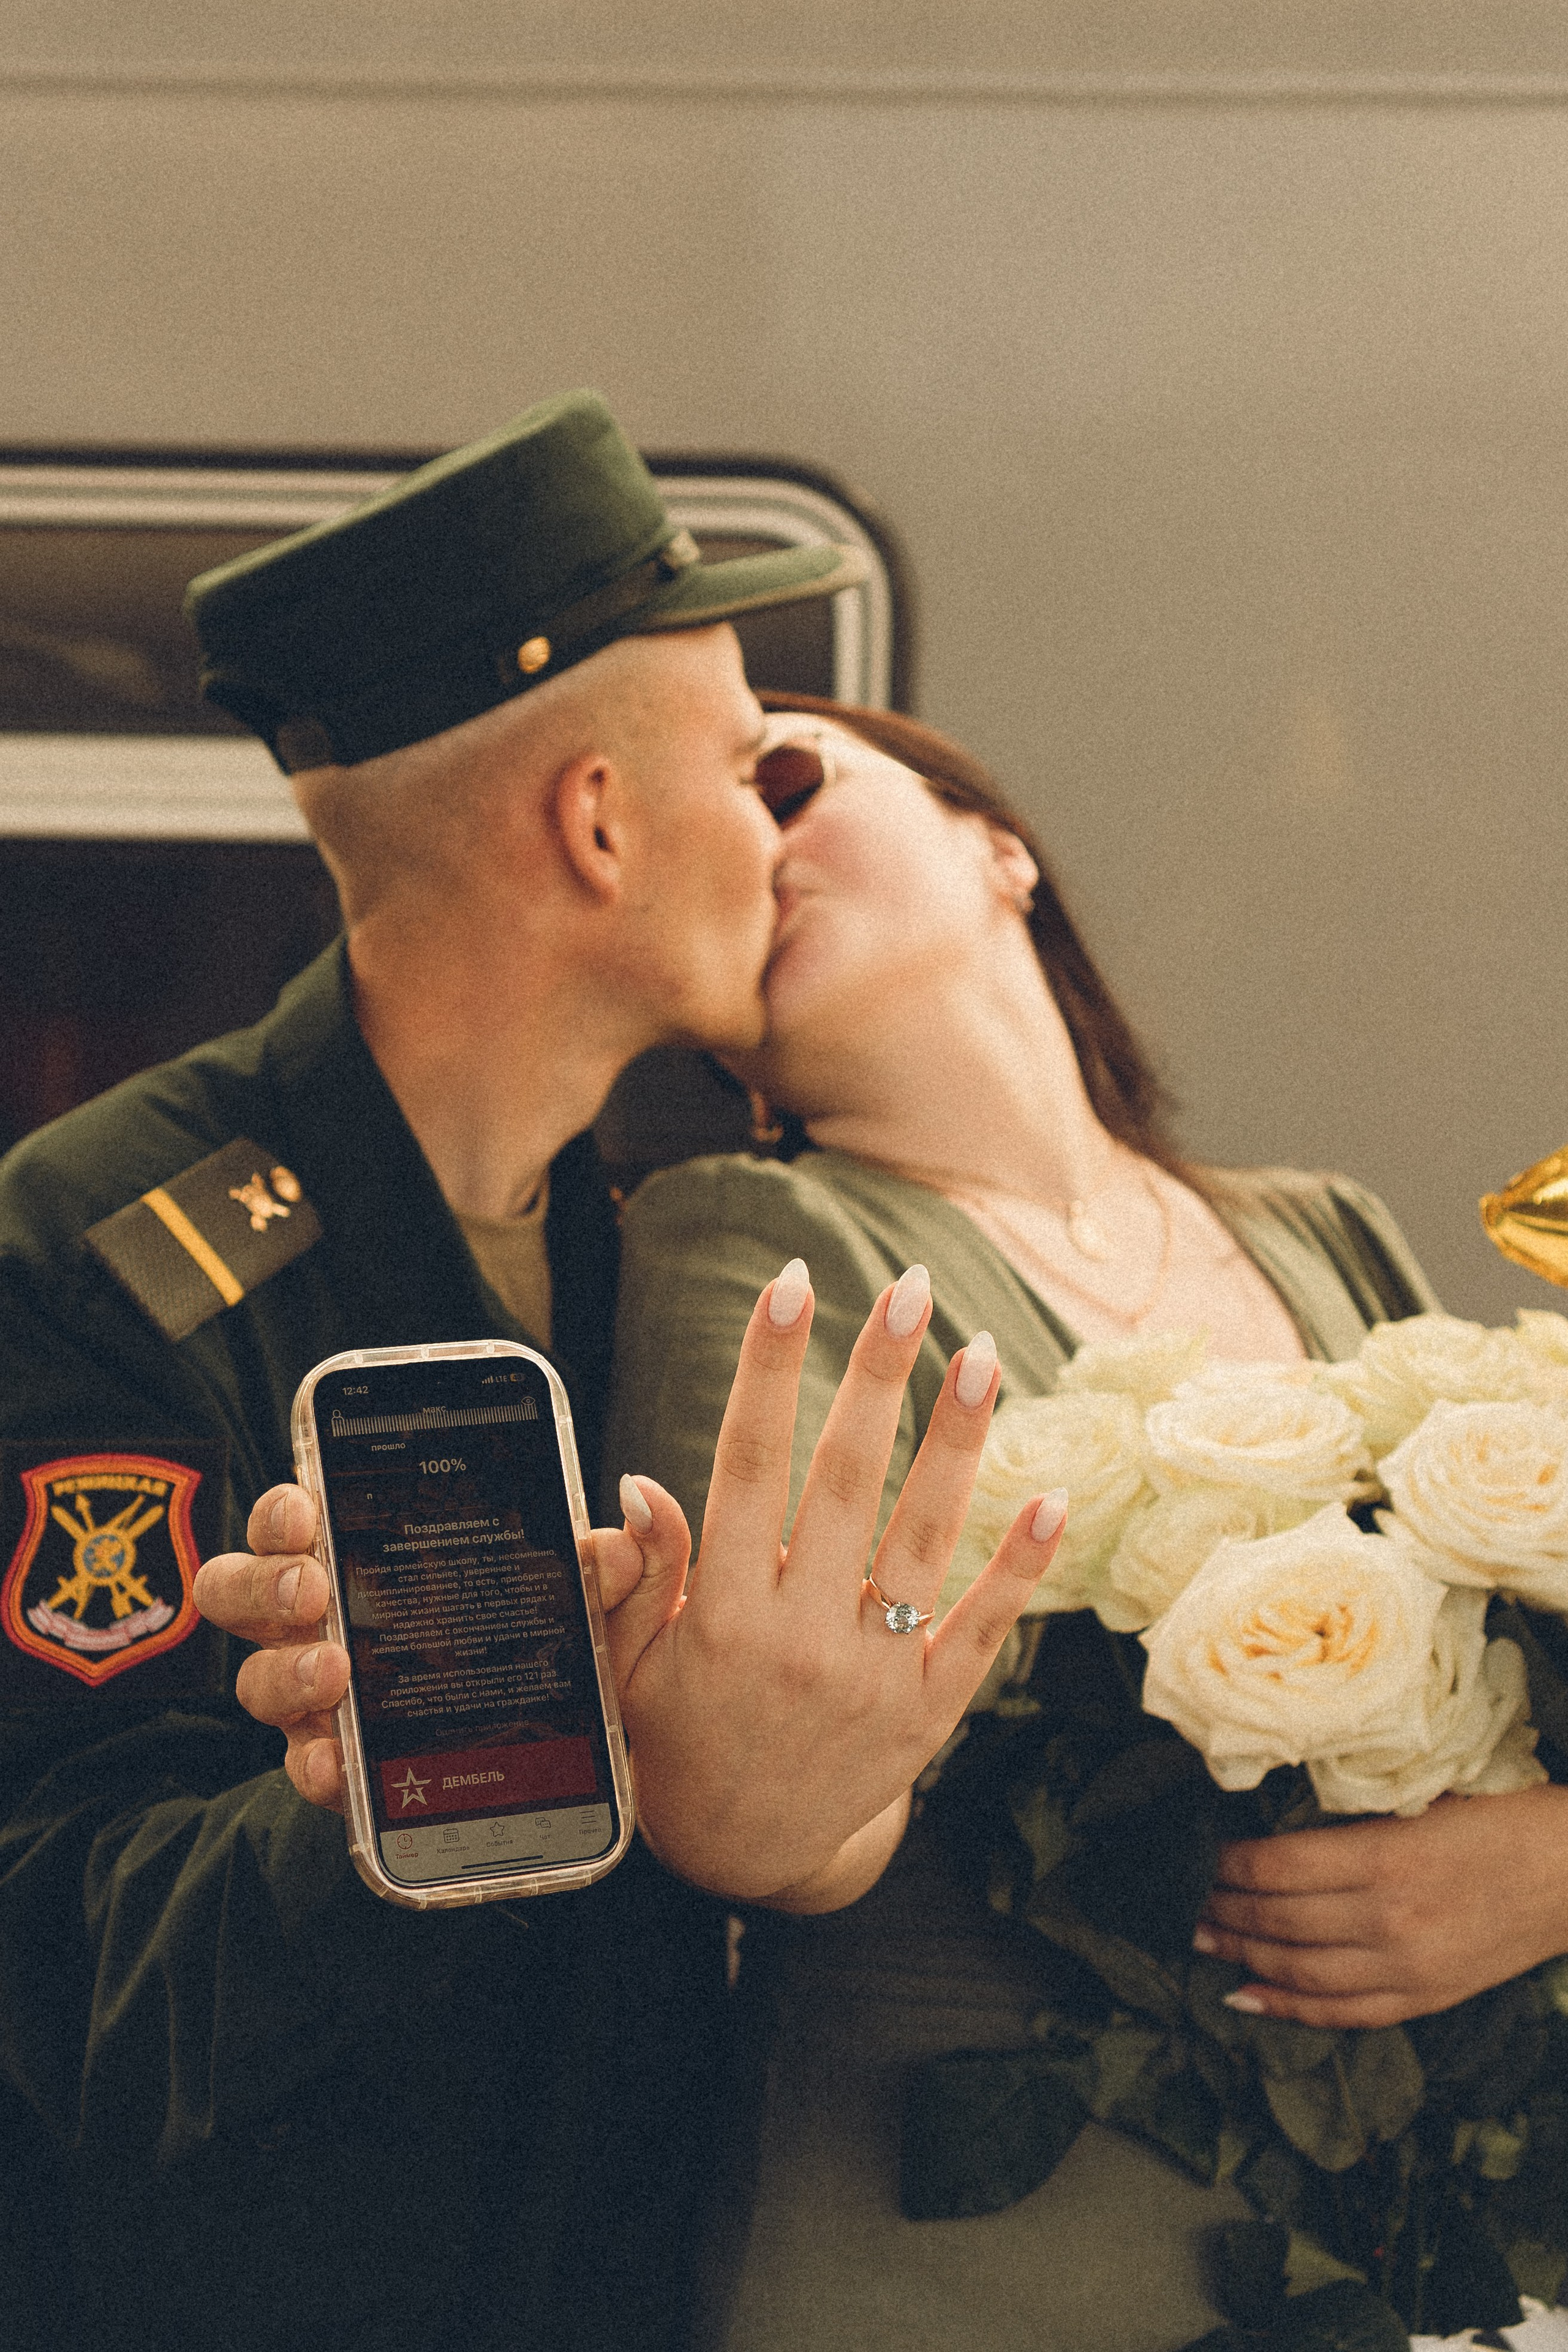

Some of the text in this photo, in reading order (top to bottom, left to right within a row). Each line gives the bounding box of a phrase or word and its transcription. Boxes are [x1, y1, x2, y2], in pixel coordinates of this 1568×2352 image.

[342, 1386, 369, 1395] 12:42
[419, 1458, 467, 1474] 100%
[404, 1518, 499, 1535] Поздравляем с
[383, 1529, 524, 1554] завершением службы!
[356, 1566, 391, 1576] Пройдя
[394, 1560, 445, 1572] армейскую
[448, 1557, 480, 1567] школу,
[499, 1550, 557, 1561] несомненно,
[421, 1570, 461, 1581] сильнее,
[464, 1566, 511, 1577] увереннее
[500, 1572, 544, 1583] приобрел
[372, 1608, 409, 1620] мирной
[410, 1607, 440, 1616] жизни
[442, 1603, 475, 1612] шагать
[484, 1599, 517, 1608] первых
[520, 1596, 547, 1605] рядах
[375, 1597, 420, 1608] качества,
[423, 1593, 459, 1604] нужные
[461, 1591, 478, 1600] для
[505, 1585, 532, 1594] чтобы
[393, 1619, 434, 1630] надежно
[437, 1615, 473, 1626] хранить
[499, 1607, 538, 1618] счастье!
[372, 1645, 409, 1654] желаем
[410, 1639, 451, 1650] большой
[454, 1637, 483, 1645] любви
[493, 1633, 520, 1642] удачи
[530, 1627, 565, 1637] мирной
[379, 1630, 442, 1643] Поздравляем
[453, 1623, 508, 1634] окончанием
[510, 1618, 546, 1629] службы
[454, 1647, 488, 1657] жизни!
[412, 1674, 440, 1683] время
[443, 1664, 513, 1678] использования
[515, 1660, 548, 1670] нашего
[382, 1696, 425, 1709] Спасибо,
[445, 1692, 469, 1701] были
[479, 1688, 505, 1697] нами,
[516, 1682, 551, 1693] желаем
[390, 1682, 448, 1697] приложения
[466, 1677, 505, 1688] открыли
[524, 1672, 538, 1681] 121
[407, 1706, 443, 1717] счастья
[454, 1703, 481, 1713] удачи
[497, 1694, 549, 1708] гражданке!
[442, 1771, 505, 1790] ДЕМБЕЛЬ
